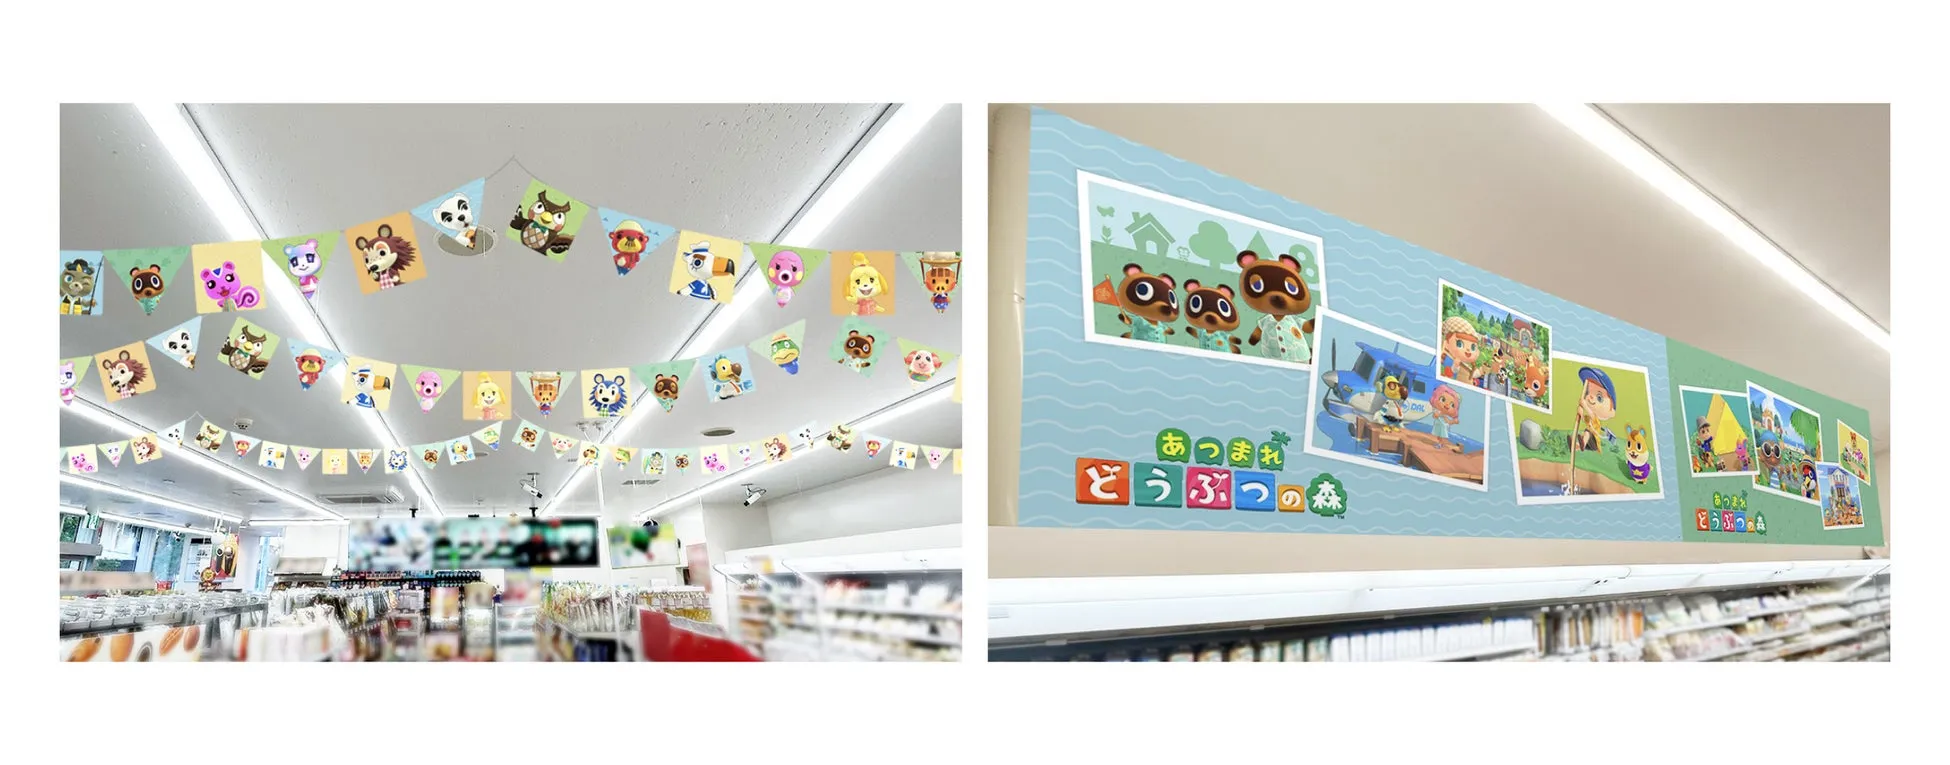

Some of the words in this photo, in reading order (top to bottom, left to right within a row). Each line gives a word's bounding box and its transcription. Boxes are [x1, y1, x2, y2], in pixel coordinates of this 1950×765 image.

[1161, 431, 1283, 466] あつまれ
[1083, 462, 1343, 508] どうぶつの森
[1714, 493, 1746, 509] あつまれ
